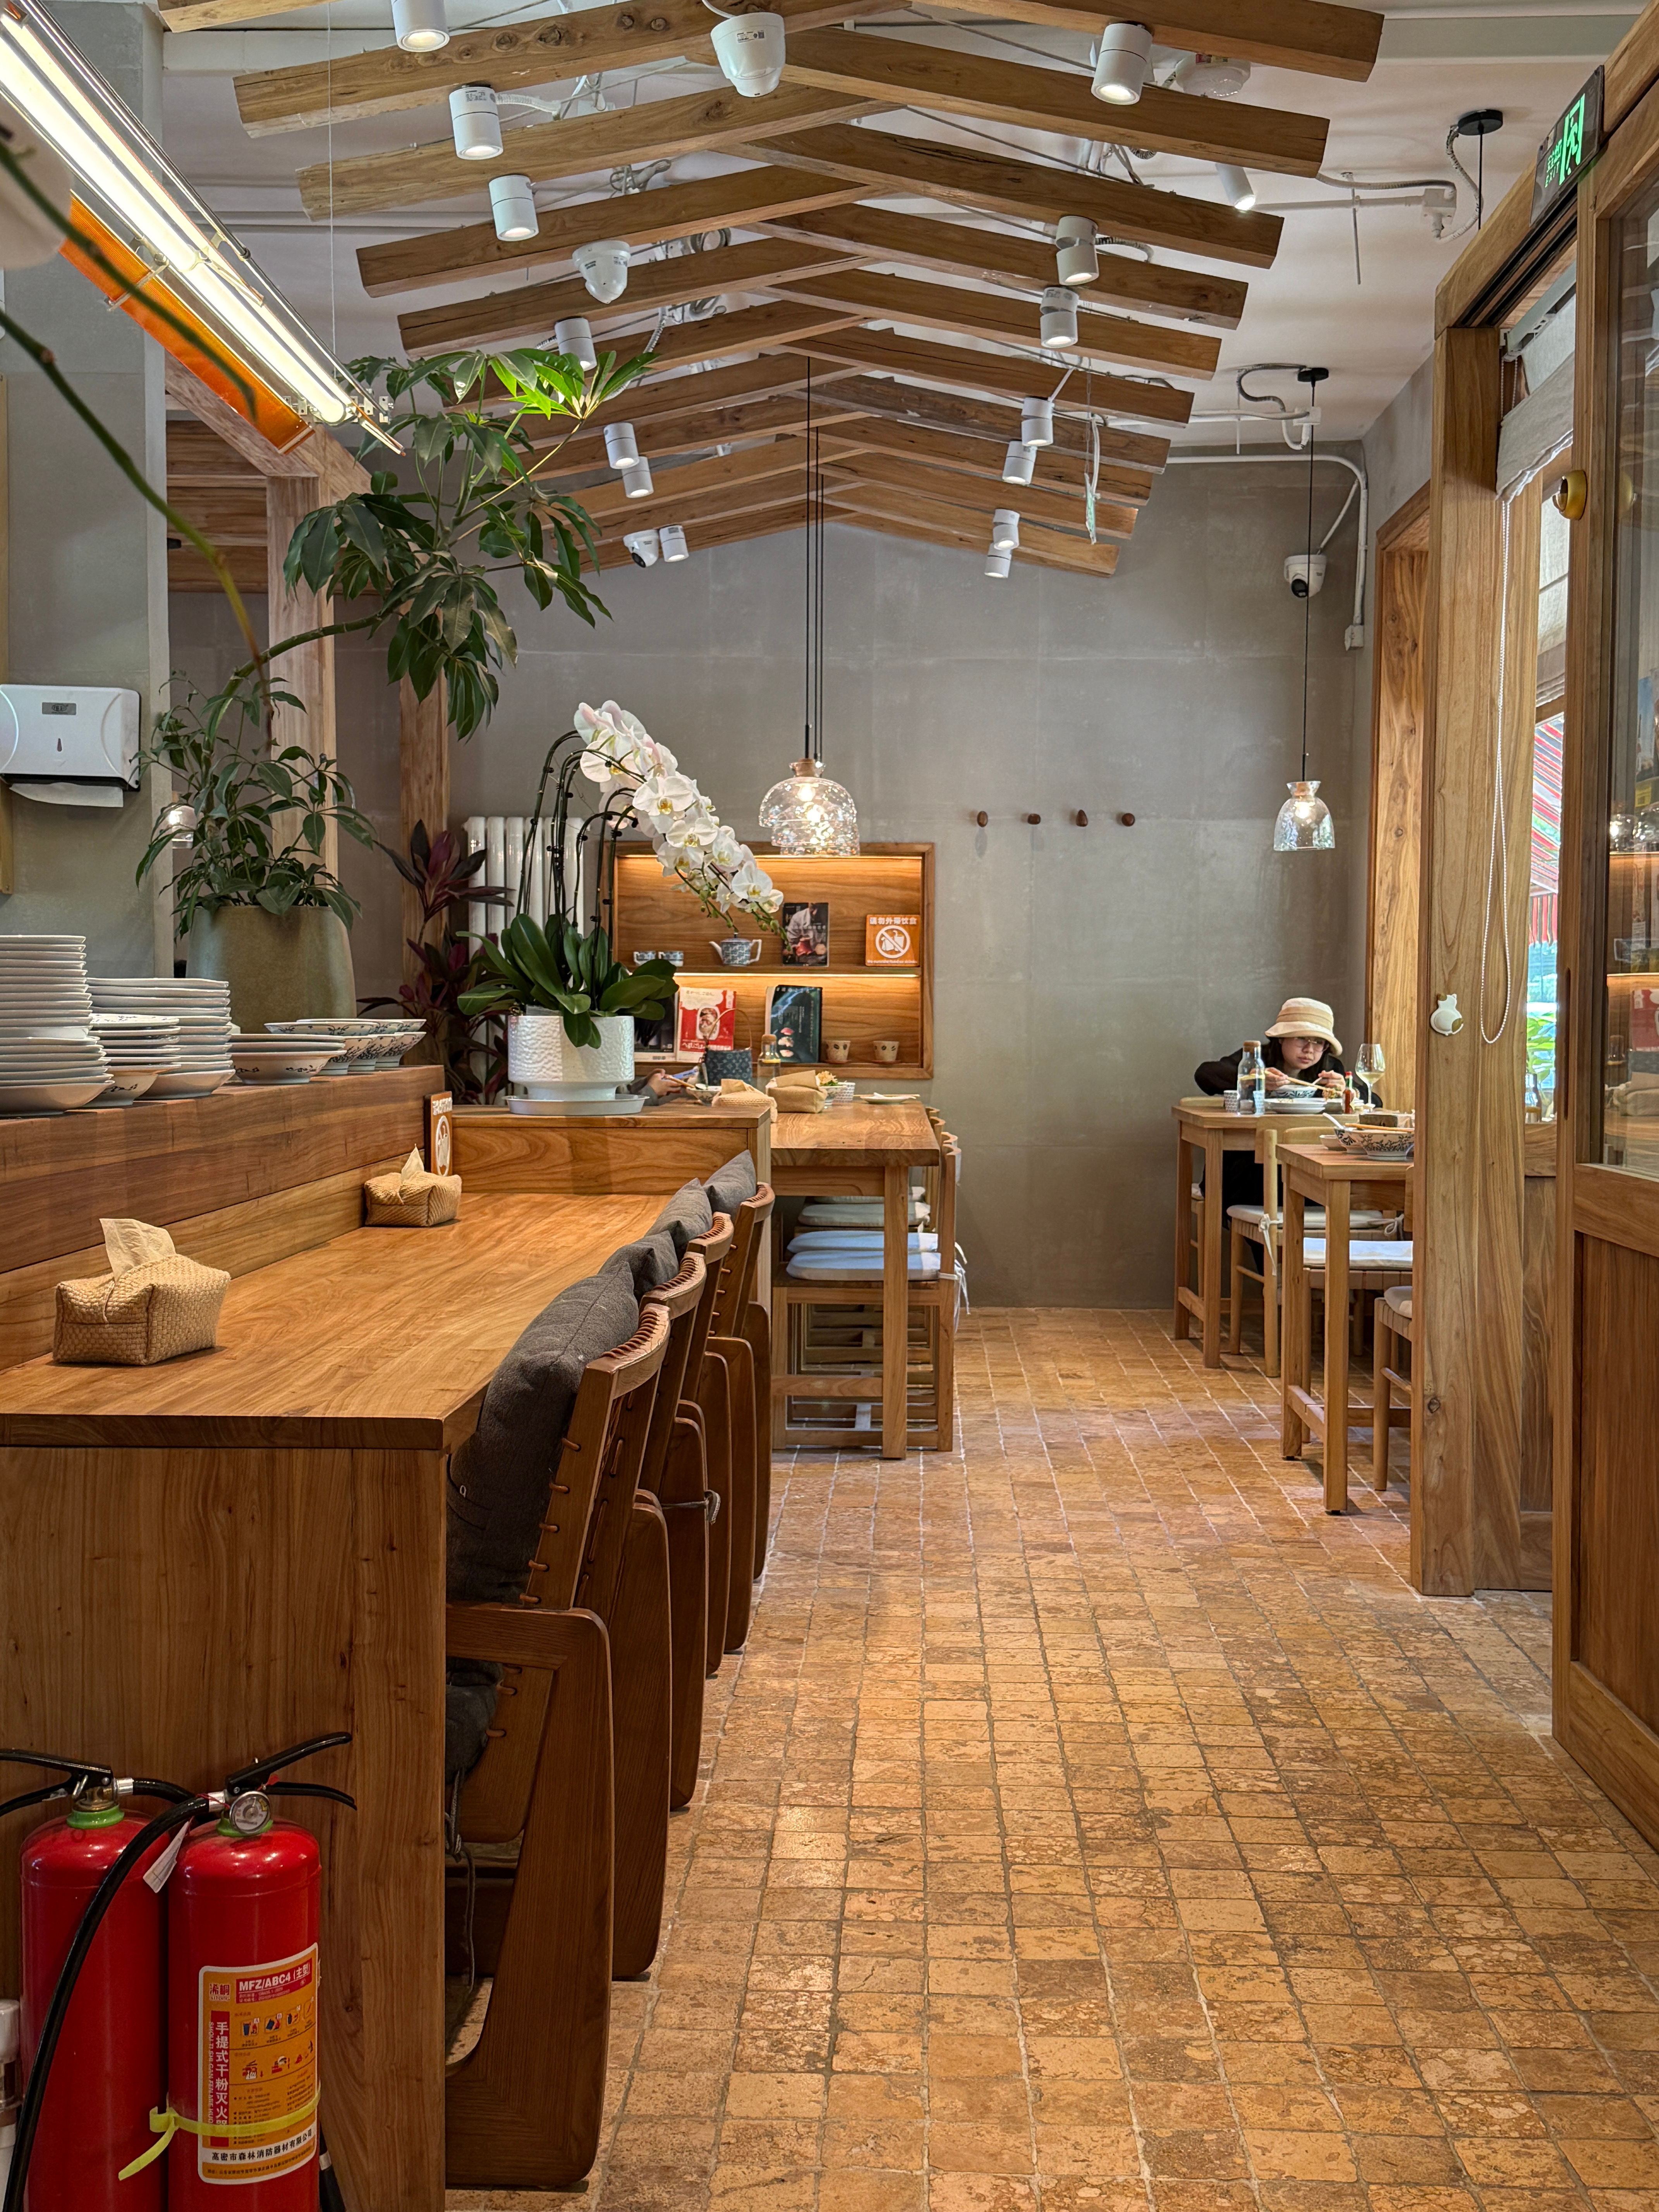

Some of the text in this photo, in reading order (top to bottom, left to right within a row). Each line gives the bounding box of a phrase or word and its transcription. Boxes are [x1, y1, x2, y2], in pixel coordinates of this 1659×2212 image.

[1545, 161, 1559, 188] EXIT
[239, 1972, 291, 1991] MFZ/ABC4
[212, 2128, 312, 2161] 高密市森林消防器材有限公司
